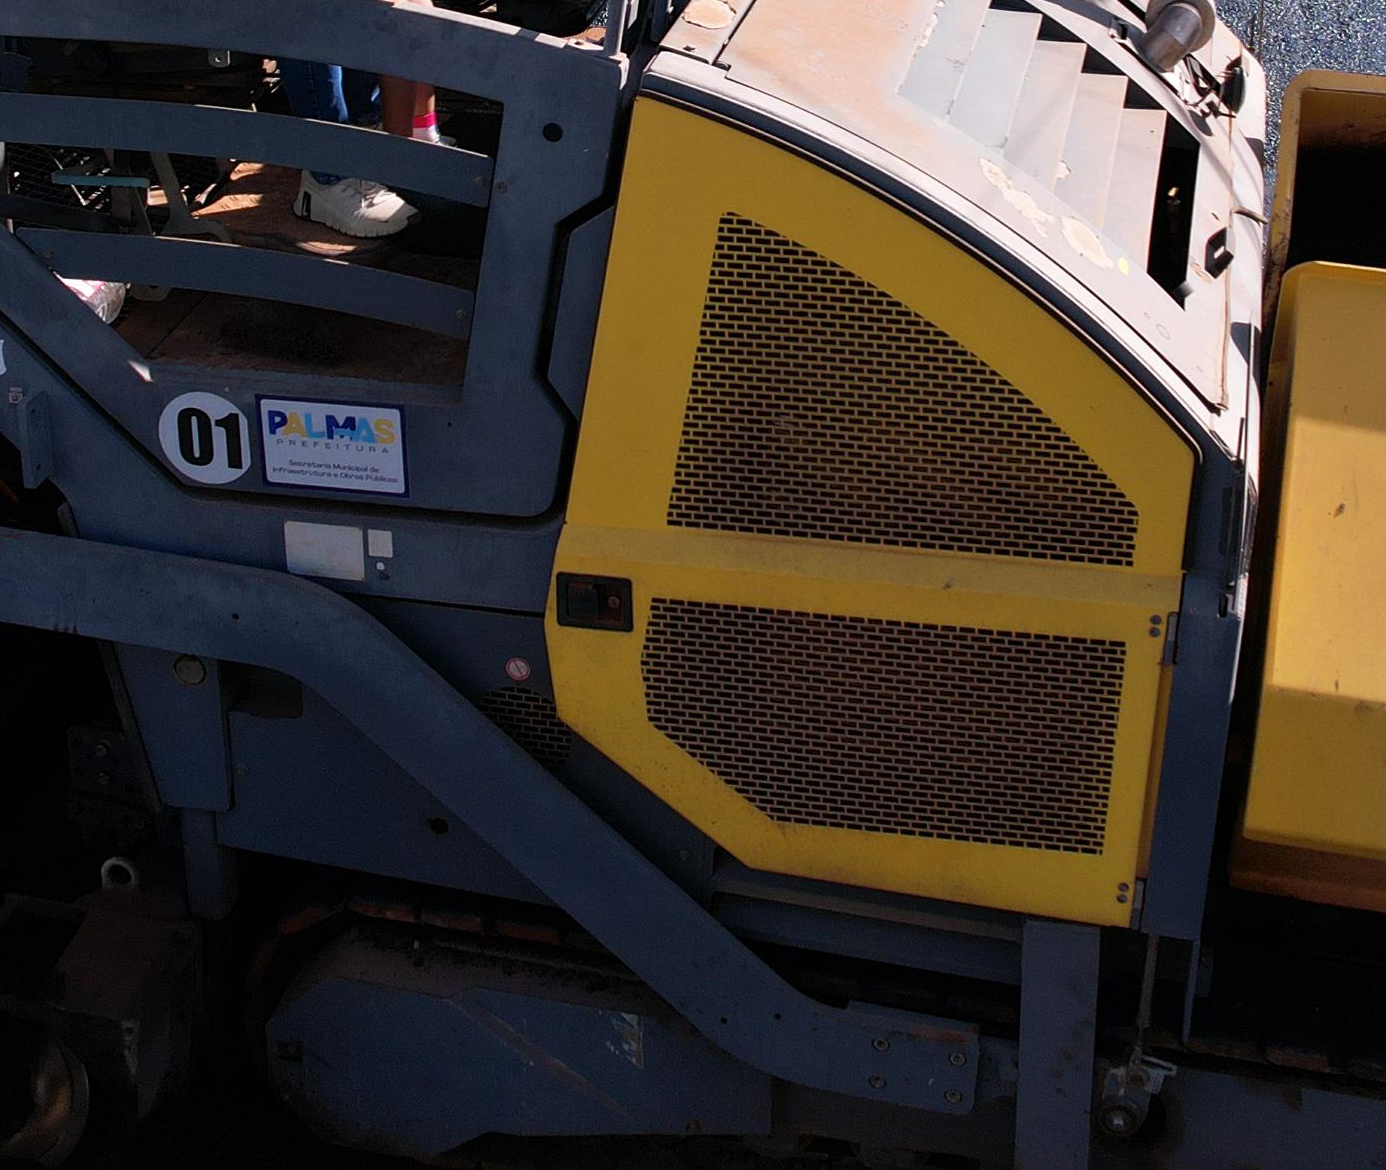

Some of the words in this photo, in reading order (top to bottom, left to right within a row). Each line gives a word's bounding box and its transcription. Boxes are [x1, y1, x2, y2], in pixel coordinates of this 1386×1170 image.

[177, 407, 243, 470] 01
[268, 410, 395, 445] PALMAS
[276, 438, 389, 454] PREFEITURA
